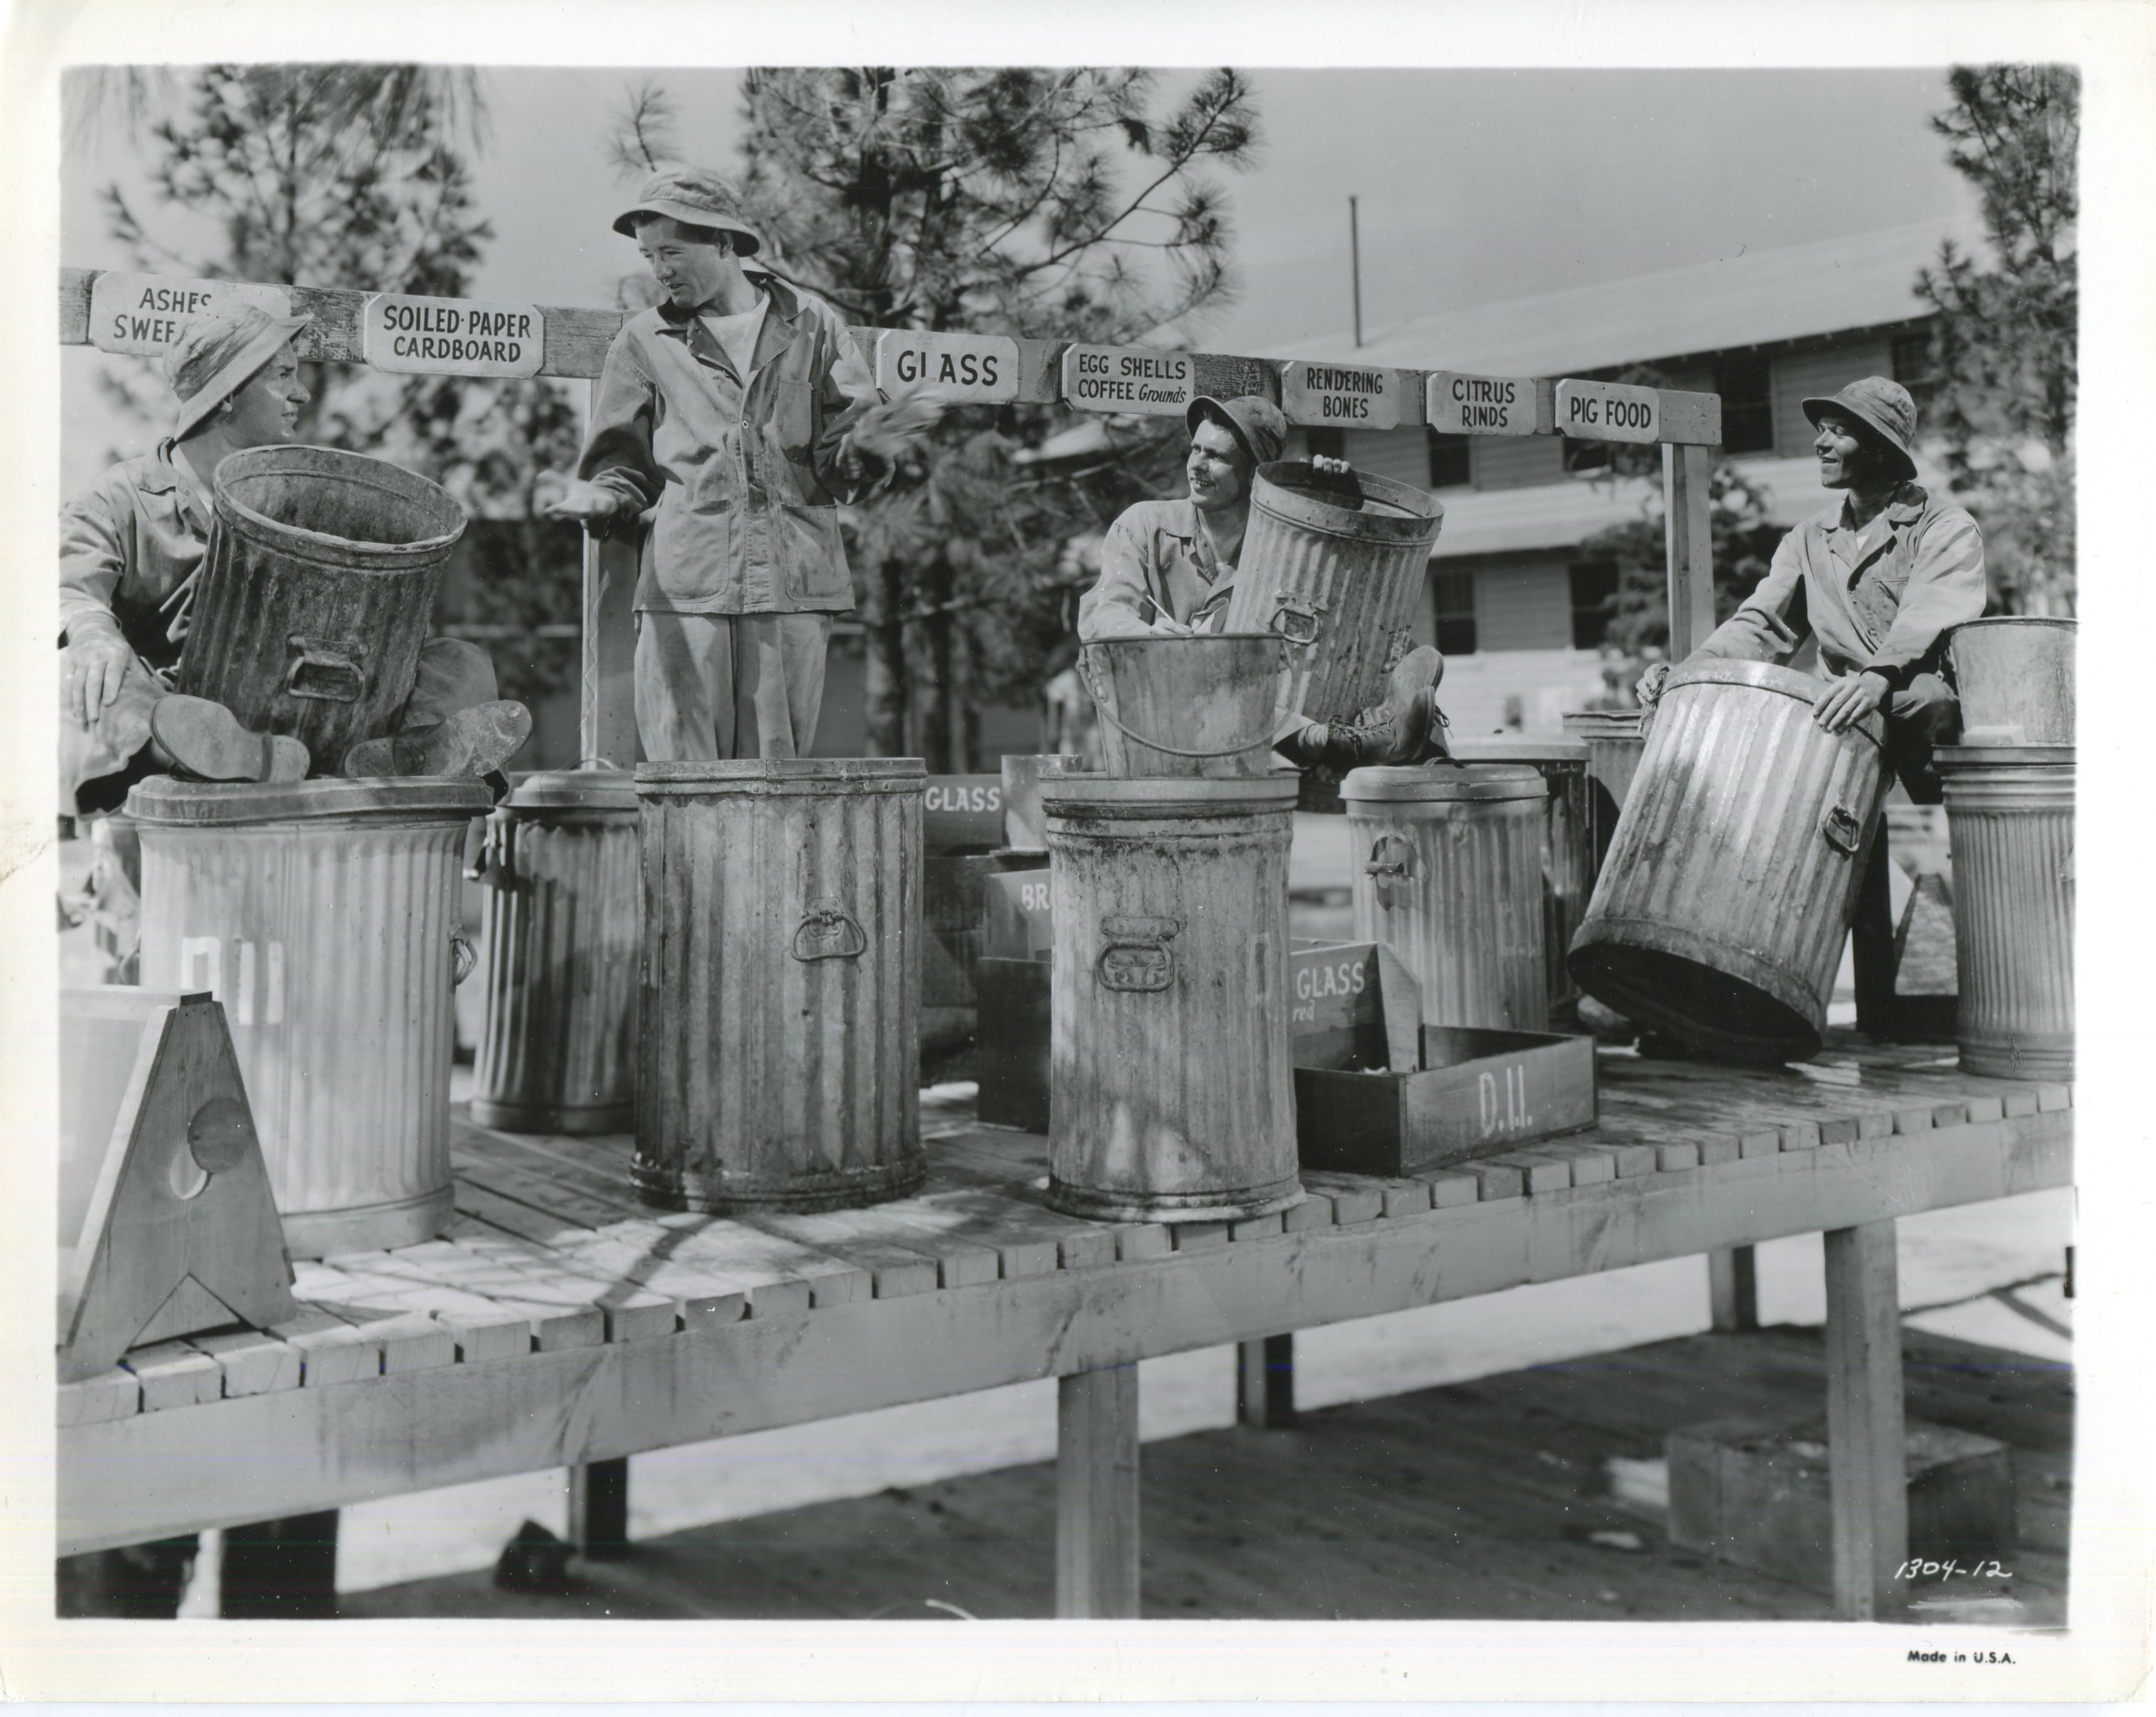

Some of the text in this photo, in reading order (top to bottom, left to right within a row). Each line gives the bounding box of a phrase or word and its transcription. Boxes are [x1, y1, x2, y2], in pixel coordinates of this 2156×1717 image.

[393, 336, 521, 363] CARDBOARD
[897, 350, 998, 386] GLASS
[1079, 354, 1186, 380] EGG SHELLS
[1078, 379, 1187, 404] COFFEE Grounds
[1306, 367, 1383, 395] RENDERING
[1452, 378, 1515, 404] CITRUS
[1323, 395, 1369, 419] BONES
[1462, 405, 1508, 427] RINDS
[1570, 396, 1651, 428] PIG FOOD
[925, 786, 1001, 812] GLASS
[1021, 883, 1051, 911] BR
[1297, 962, 1365, 1000] GLASS
